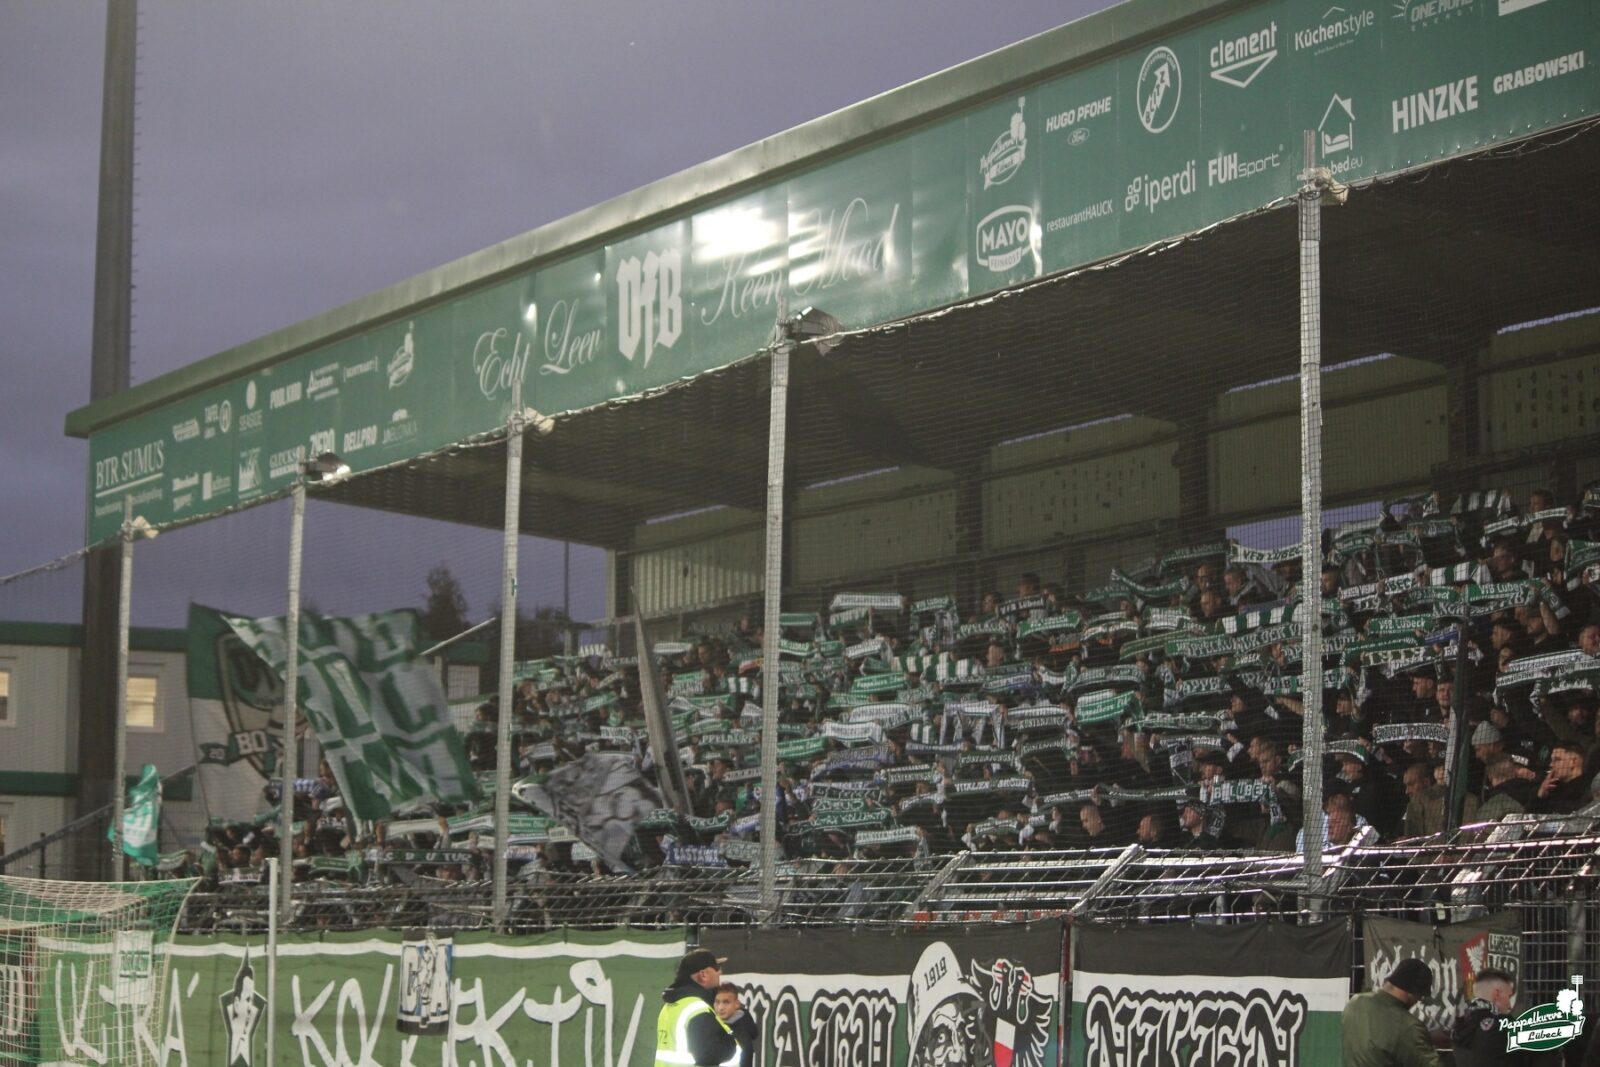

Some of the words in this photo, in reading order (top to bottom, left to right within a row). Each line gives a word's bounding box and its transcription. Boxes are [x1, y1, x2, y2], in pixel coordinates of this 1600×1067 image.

[1210, 21, 1277, 68] clement
[1295, 10, 1374, 51] Küchenstyle
[1493, 50, 1585, 95] GRABOWSKI
[1046, 109, 1075, 133] HUGO
[1077, 96, 1111, 122] PFOHE
[1392, 75, 1478, 134] HINZKE
[1144, 160, 1196, 213] iperdi
[982, 217, 1028, 252] MAYO
[96, 456, 119, 490] BTR
[121, 440, 164, 481] SUMUS
[924, 957, 947, 990] 1919
